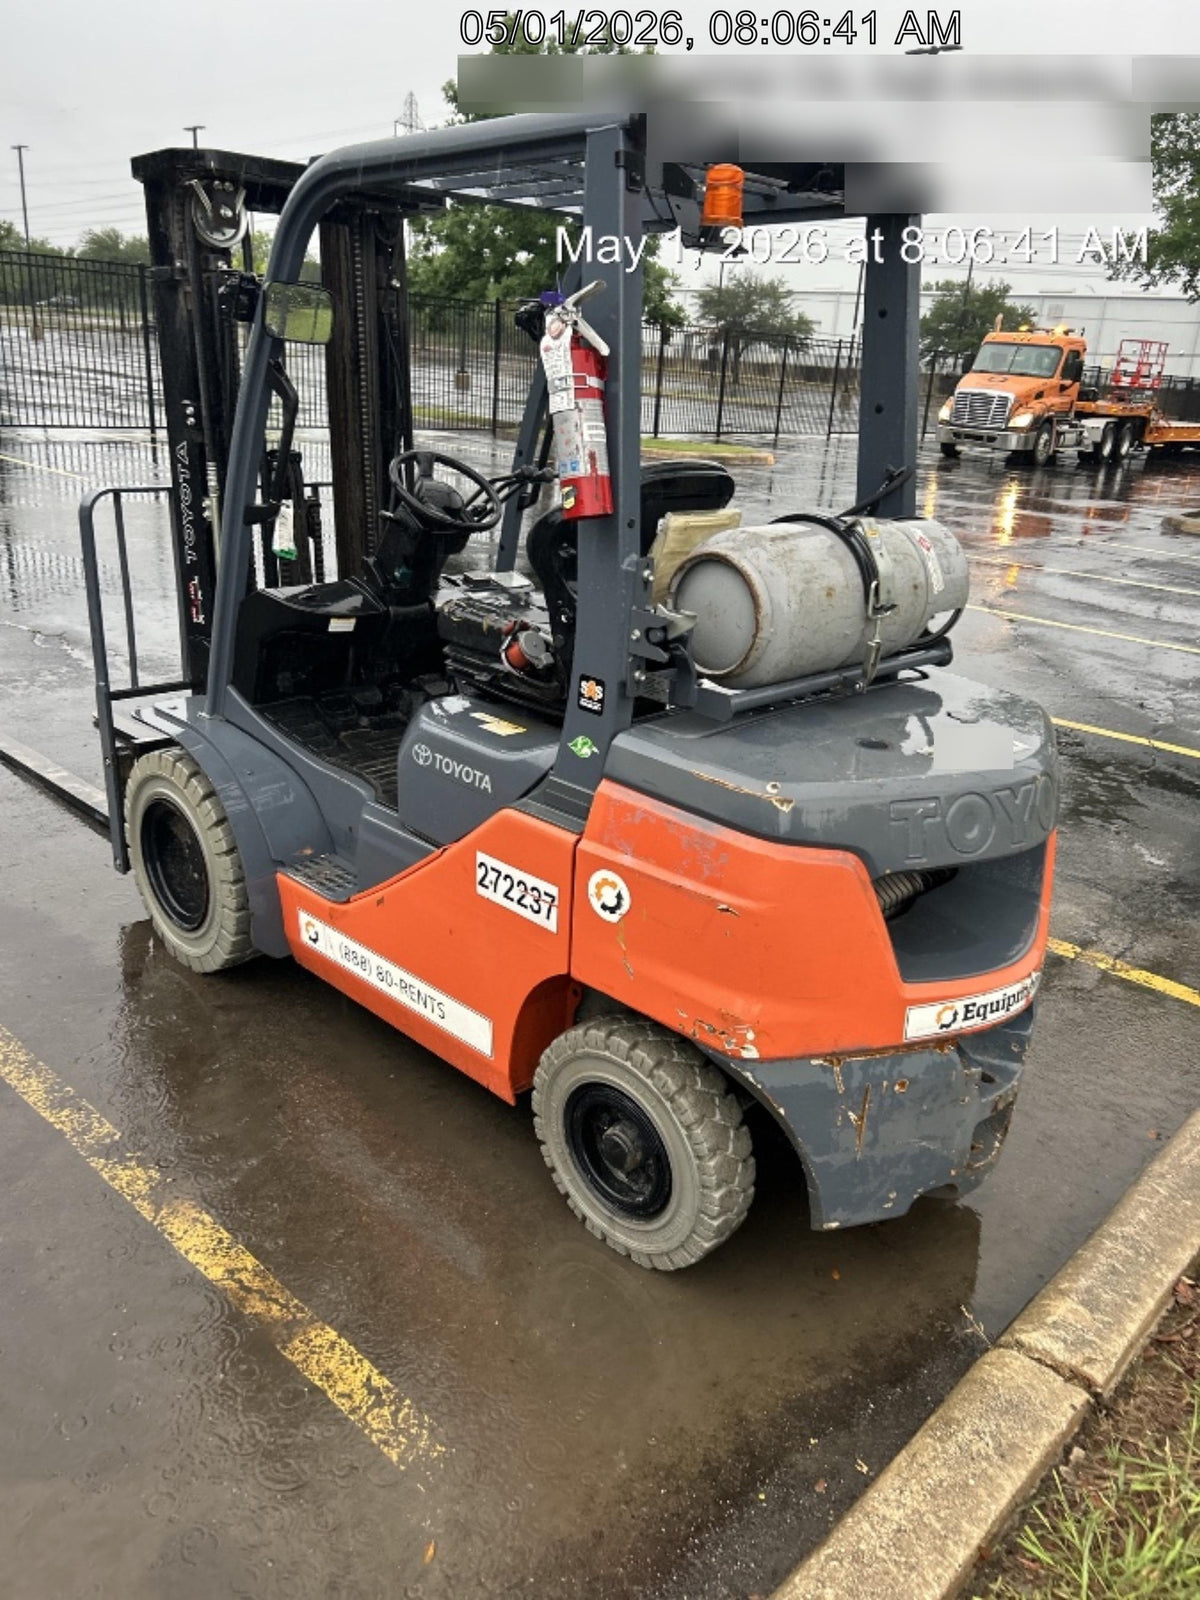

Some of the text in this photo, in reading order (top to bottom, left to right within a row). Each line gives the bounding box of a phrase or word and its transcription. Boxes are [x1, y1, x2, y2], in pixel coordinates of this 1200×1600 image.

[176, 441, 198, 564] TOYOTA
[434, 752, 493, 793] TOYOTA
[477, 862, 557, 921] 272237
[338, 941, 446, 1020] (888) 80-RENTS
